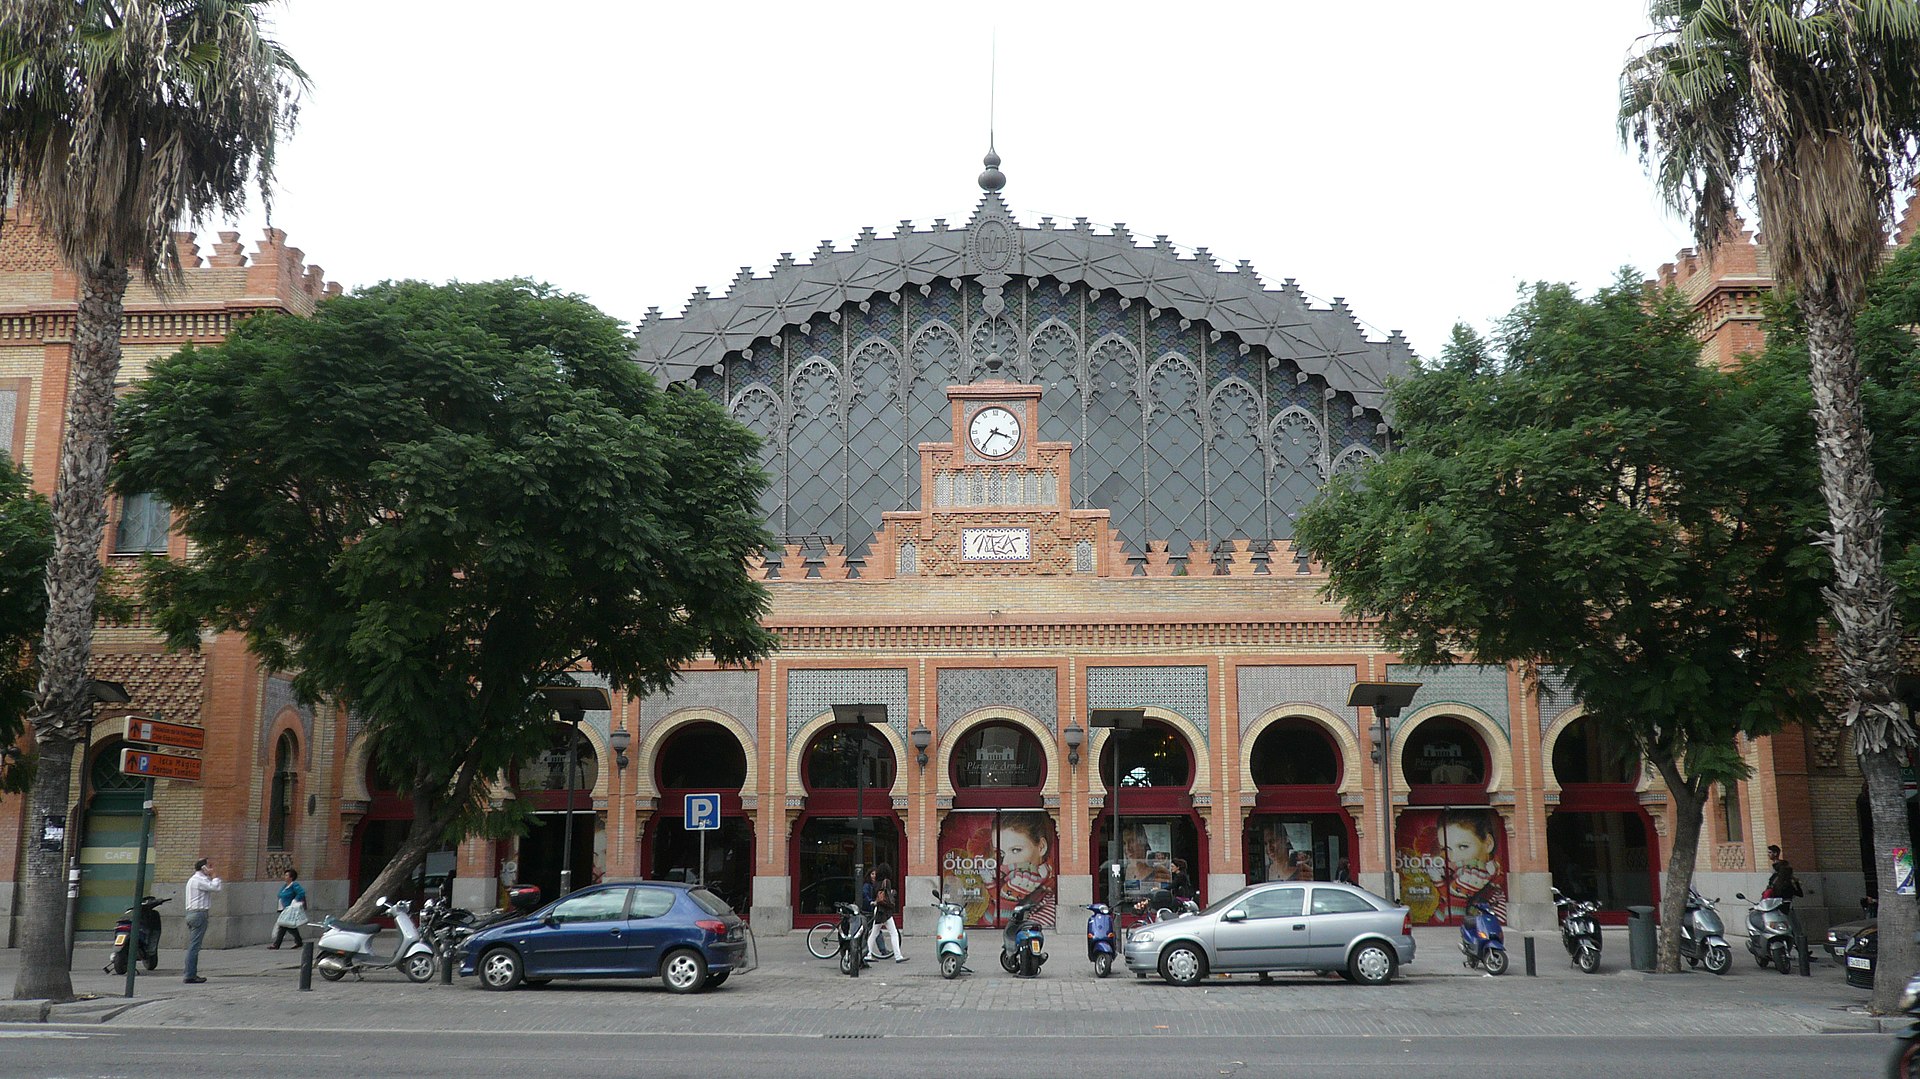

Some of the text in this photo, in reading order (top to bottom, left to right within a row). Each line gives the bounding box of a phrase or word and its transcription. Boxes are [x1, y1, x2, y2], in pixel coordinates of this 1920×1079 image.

[140, 756, 148, 770] P
[692, 799, 713, 826] P
[944, 855, 997, 870] otoño
[1396, 853, 1444, 868] otoño
